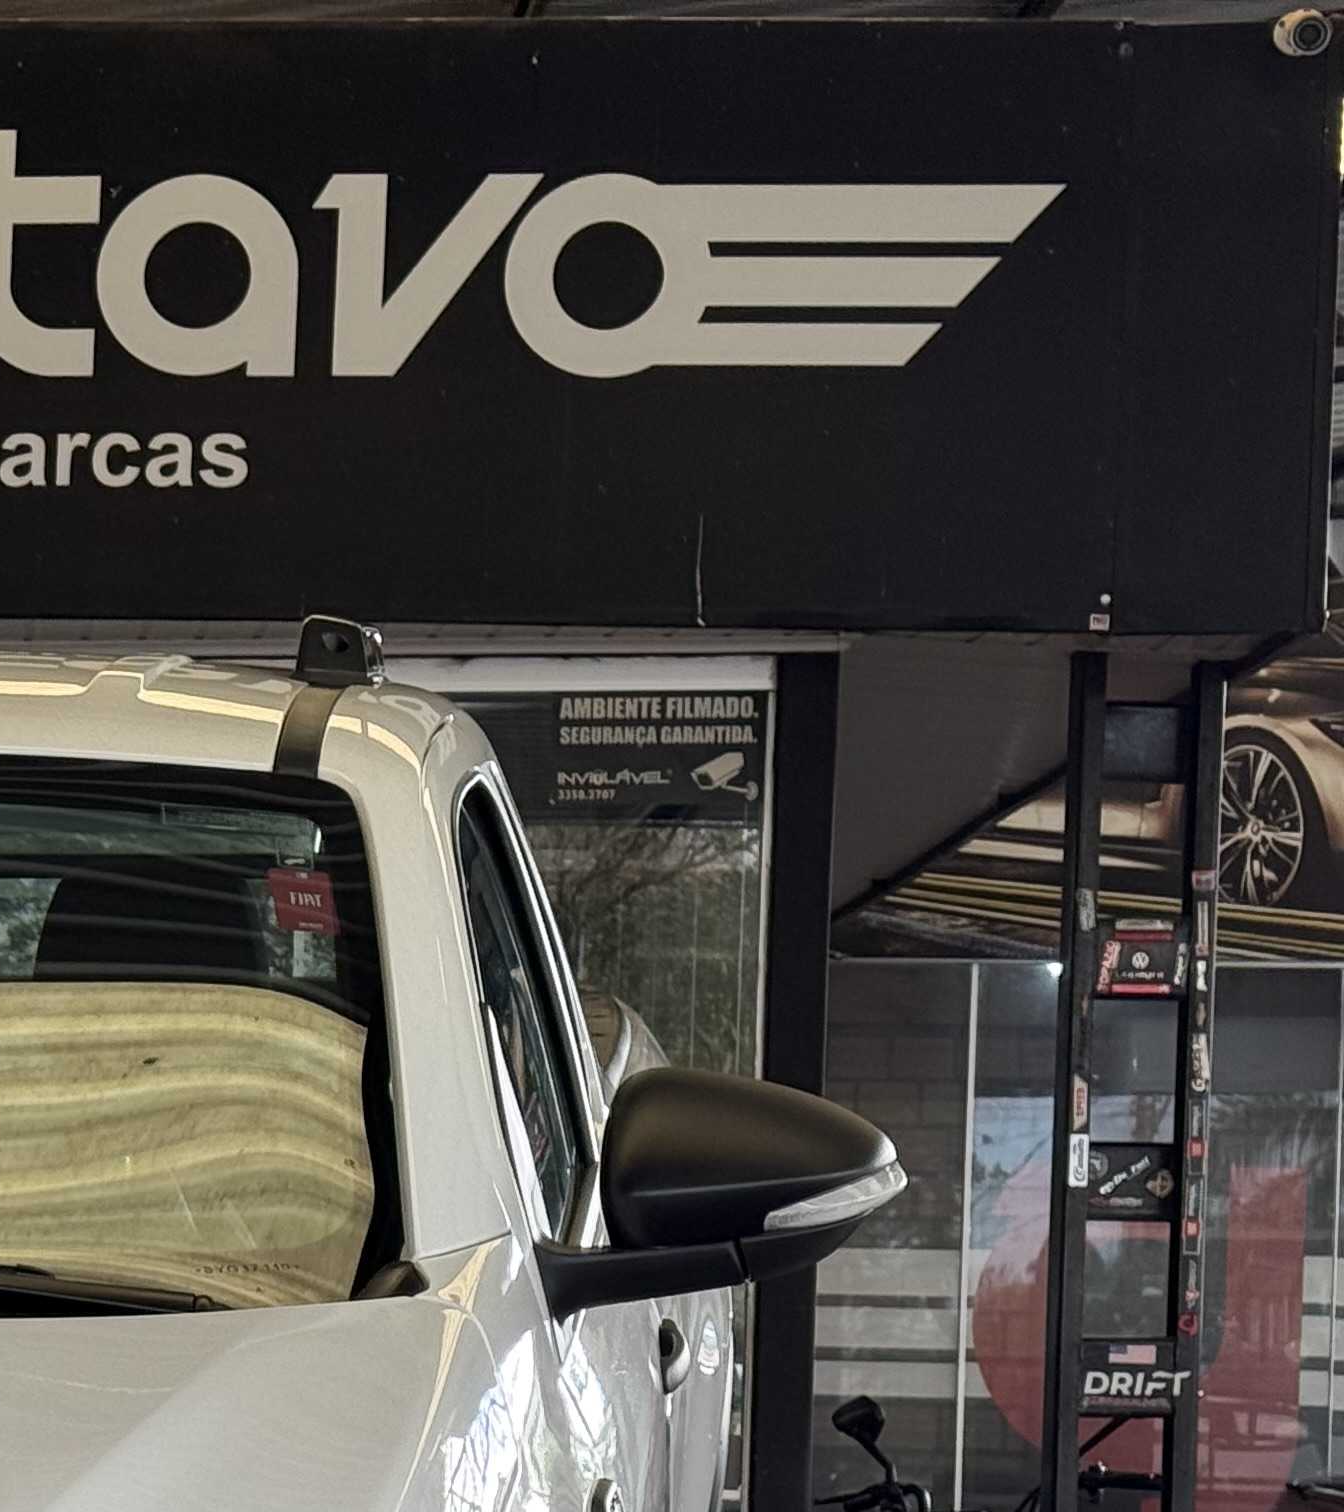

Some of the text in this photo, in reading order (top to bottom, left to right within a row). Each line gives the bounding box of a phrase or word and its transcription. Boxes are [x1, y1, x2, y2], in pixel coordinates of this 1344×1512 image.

[559, 696, 760, 720] AMBIENTE FILMADO.
[559, 725, 758, 748] SEGURANÇA GARANTIDA.
[1083, 1370, 1193, 1397] DRIFT
